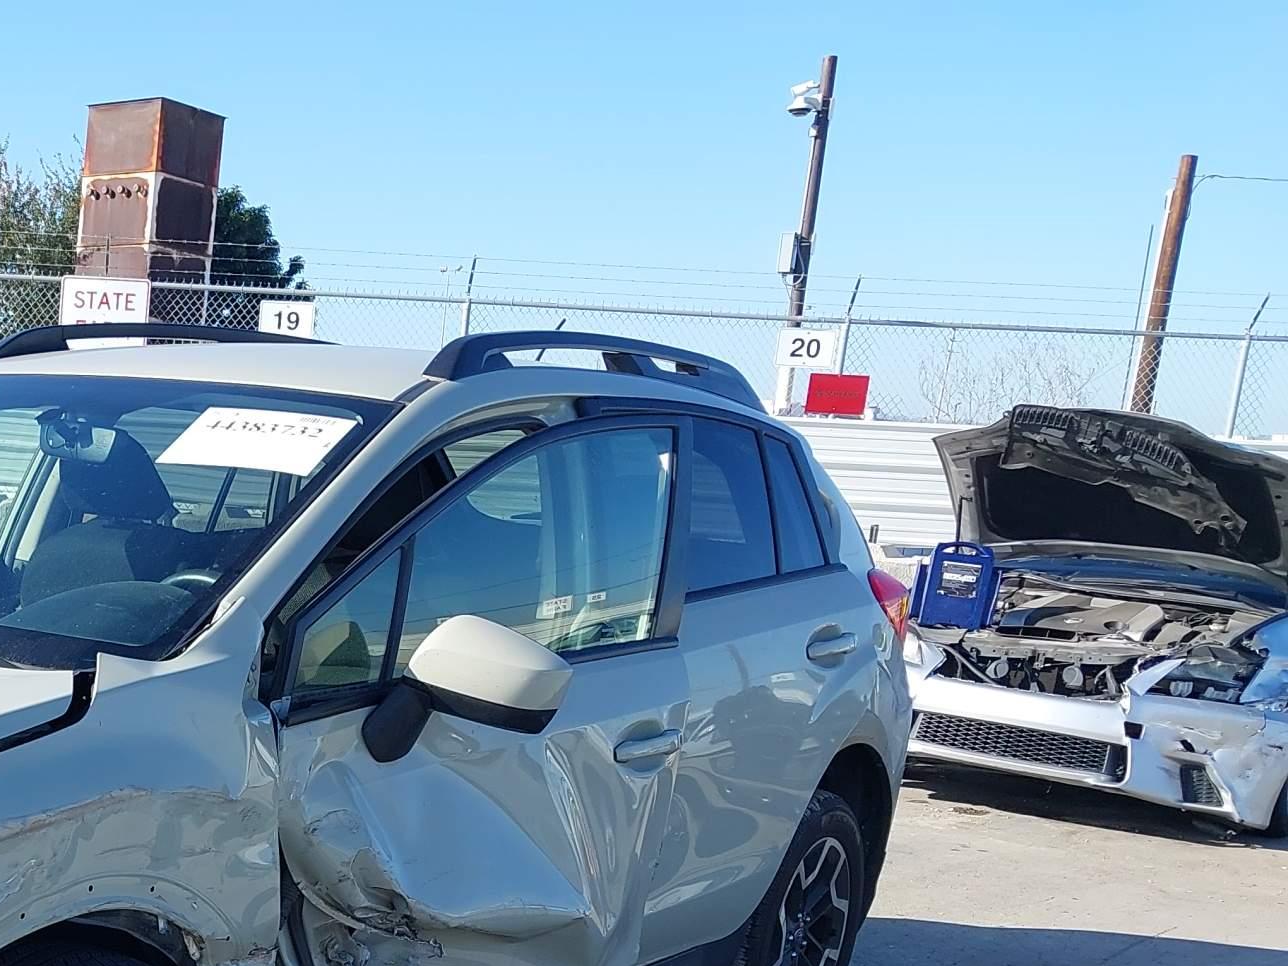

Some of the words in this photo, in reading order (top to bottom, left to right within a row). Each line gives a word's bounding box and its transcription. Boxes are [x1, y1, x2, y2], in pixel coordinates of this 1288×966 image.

[73, 290, 137, 312] STATE
[273, 310, 300, 331] 19
[789, 337, 821, 359] 20
